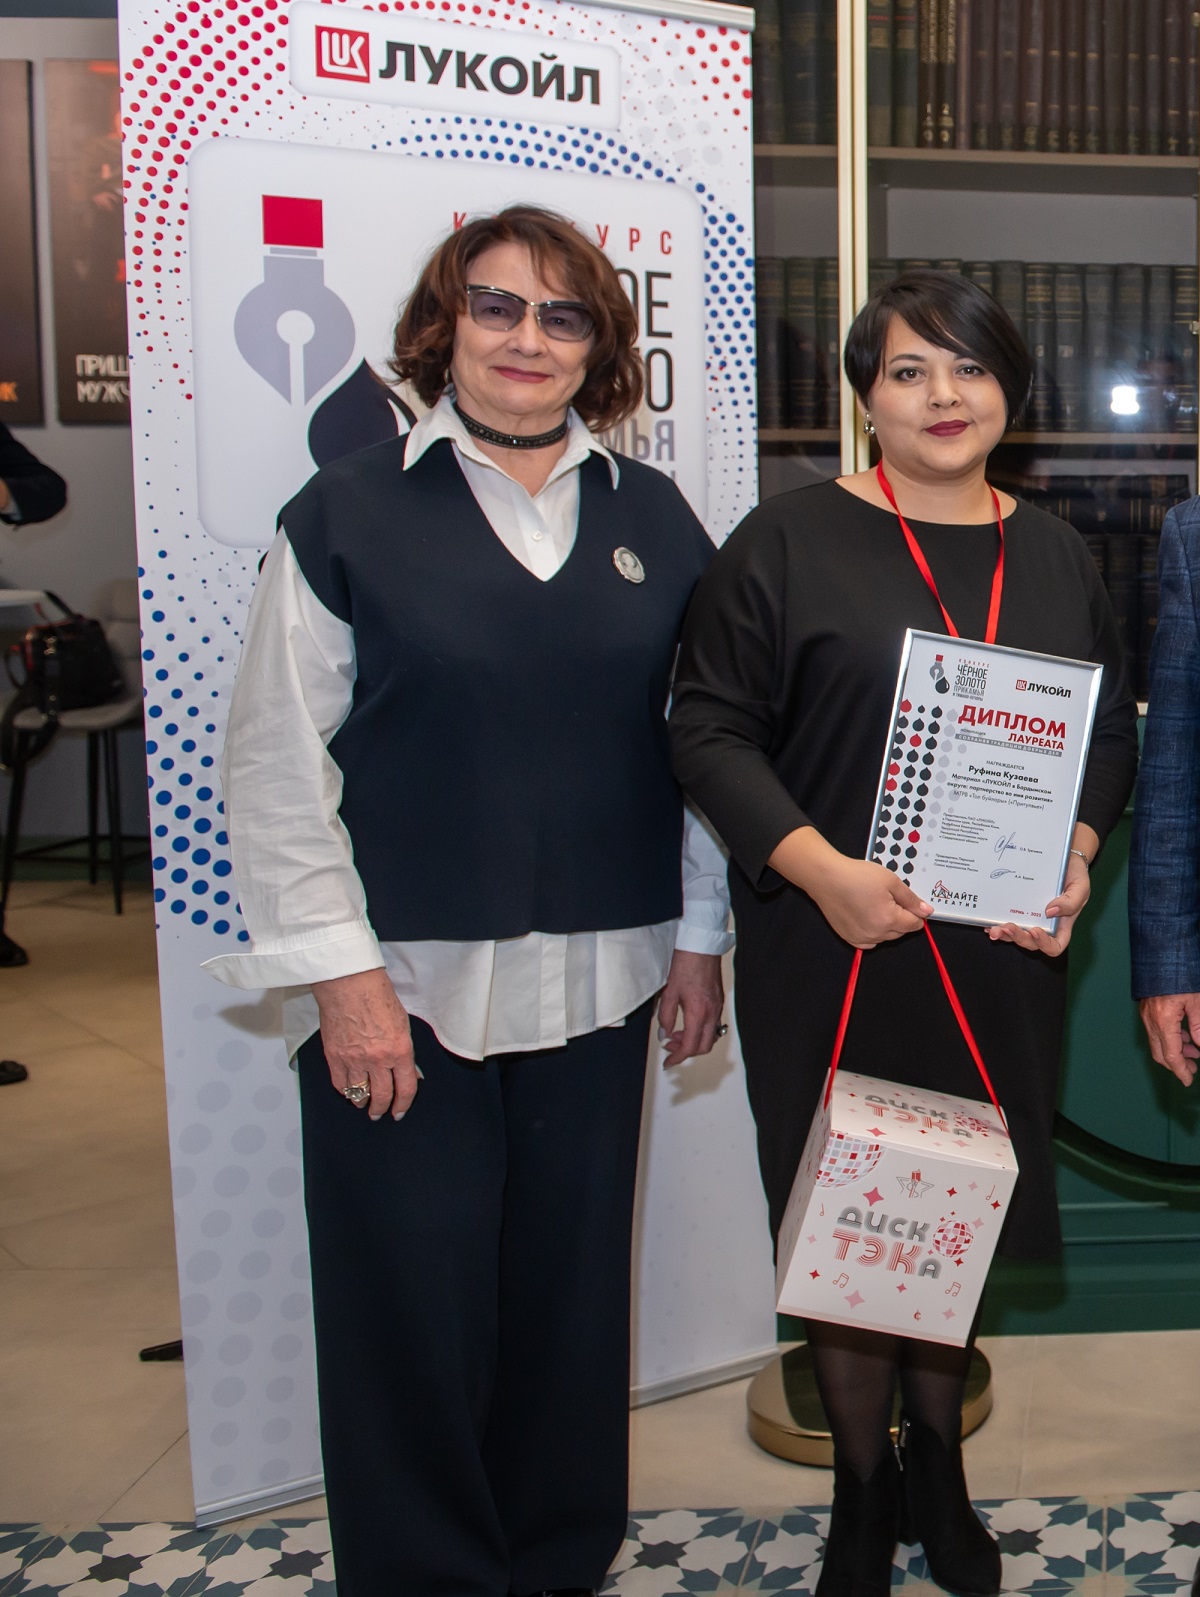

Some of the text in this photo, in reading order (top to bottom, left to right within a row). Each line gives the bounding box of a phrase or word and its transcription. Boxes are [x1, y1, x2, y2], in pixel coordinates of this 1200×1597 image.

[378, 40, 601, 105] ЛУКОЙЛ
[958, 664, 988, 679] ЧЁРНОЕ
[955, 675, 986, 690] ЗОЛОТО
[1026, 682, 1071, 698] ЛУКОЙЛ
[954, 685, 984, 696] ПРИКАМЬЯ
[958, 704, 1066, 738] ДИПЛОМ
[1008, 733, 1064, 750] ЛАУРЕАТА
[986, 760, 1024, 770] НАГРАЖДАЕТСЯ
[952, 773, 980, 783] Материал
[982, 778, 1011, 788] «ЛУКОЙЛ
[969, 765, 1038, 783] Руфина Кузаева
[931, 889, 978, 902] КАЧАЙТЕ
[931, 898, 977, 908] КРЕАТИВ
[864, 1094, 948, 1121] ДИСК
[836, 1205, 931, 1243] ДИСК
